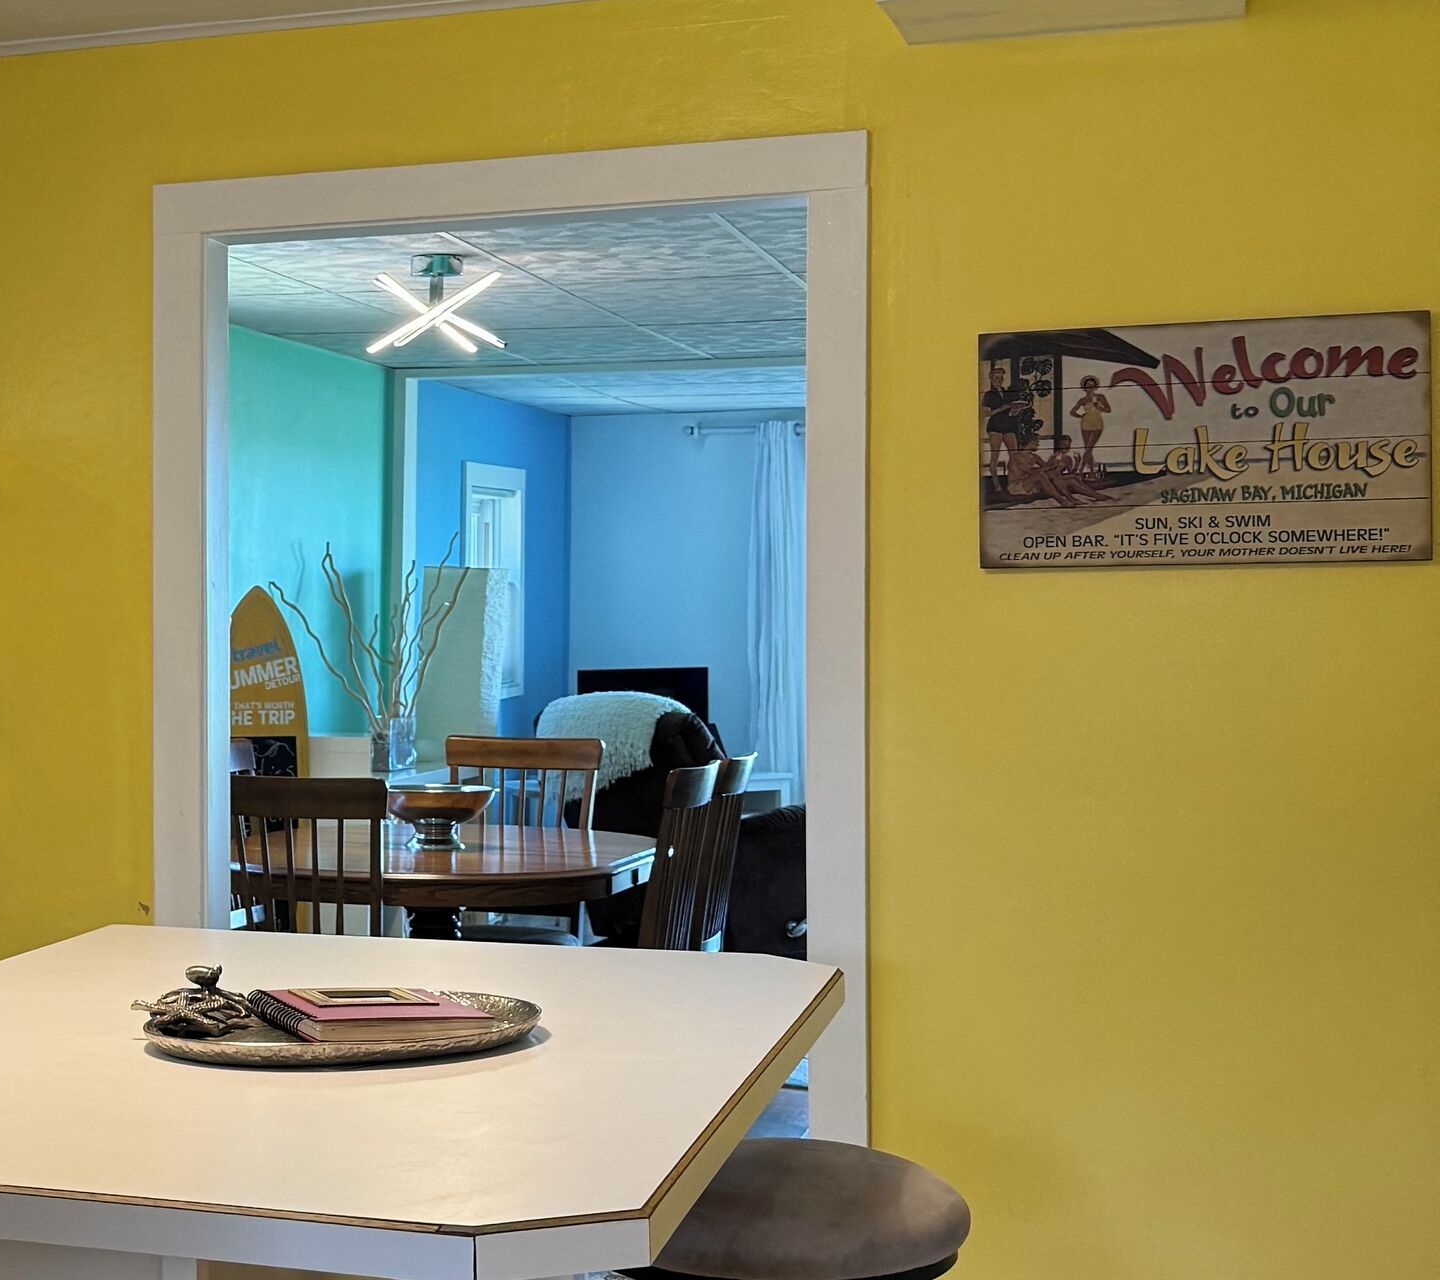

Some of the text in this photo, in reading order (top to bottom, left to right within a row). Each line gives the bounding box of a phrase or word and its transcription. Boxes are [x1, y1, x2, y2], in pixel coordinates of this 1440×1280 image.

[1111, 335, 1419, 420] Welcome
[1230, 386, 1335, 419] to Our
[1133, 422, 1420, 480] Lake House
[1160, 482, 1368, 504] SAGINAW BAY, MICHIGAN
[1135, 514, 1271, 531] SUN, SKI & SWIM
[1023, 535, 1067, 549] OPEN
[1072, 534, 1109, 548] BAR.
[1153, 532, 1189, 545] FIVE
[1194, 530, 1263, 545] O'CLOCK
[1268, 528, 1390, 543] SOMEWHERE!"
[999, 544, 1412, 561] CLEAN UP AFTER YOURSELF, YOUR MOTHER DOESN'T LIVE HERE!
[230, 656, 298, 690] UMMER
[231, 709, 296, 726] HE TRIP
